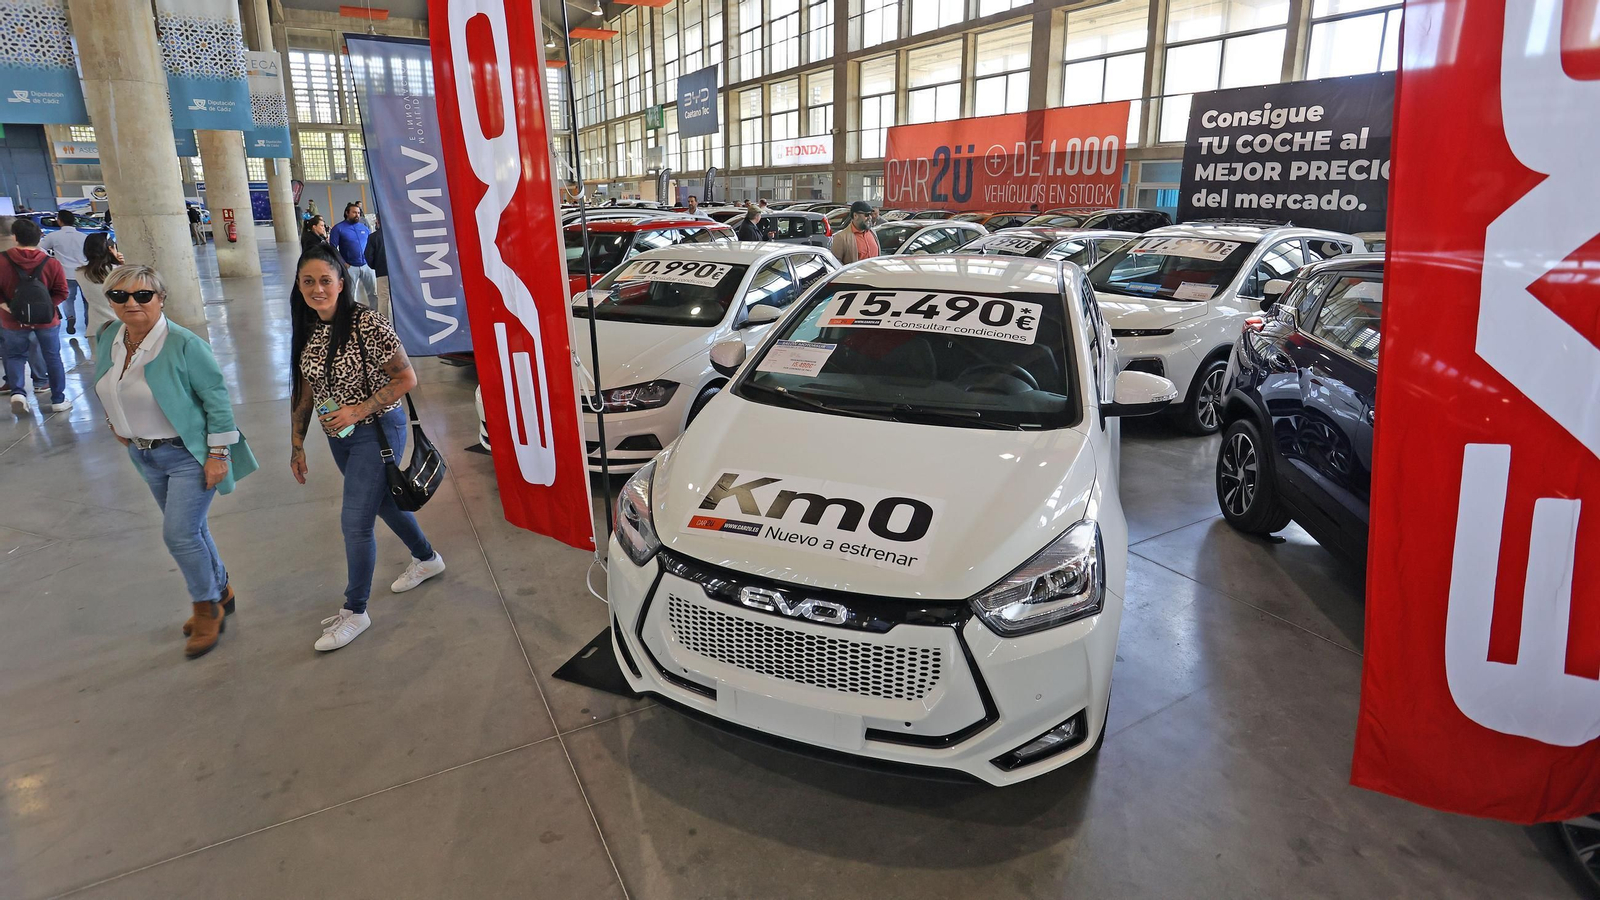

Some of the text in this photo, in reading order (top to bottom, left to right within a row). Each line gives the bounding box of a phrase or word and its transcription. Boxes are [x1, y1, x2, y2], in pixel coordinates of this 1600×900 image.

[246, 59, 278, 70] ECA
[30, 90, 65, 98] Diputación
[42, 97, 60, 105] Cádiz
[684, 87, 709, 107] BYD
[684, 106, 710, 119] Caetano Tec
[1201, 102, 1325, 129] Consigue
[785, 144, 827, 157] HONDA
[1198, 126, 1370, 155] TU COCHE al
[1013, 140, 1043, 177] DE
[1049, 134, 1119, 177] 1.000
[886, 144, 975, 203] CAR2Ü
[1194, 160, 1283, 182] MEJOR
[984, 180, 1115, 205] VEHÍCULOS EN STOCK
[1191, 188, 1368, 212] del mercado.
[893, 319, 1027, 342] Consultar condiciones
[764, 525, 918, 568] Nuevo a estrenar
[740, 585, 848, 625] EVO
